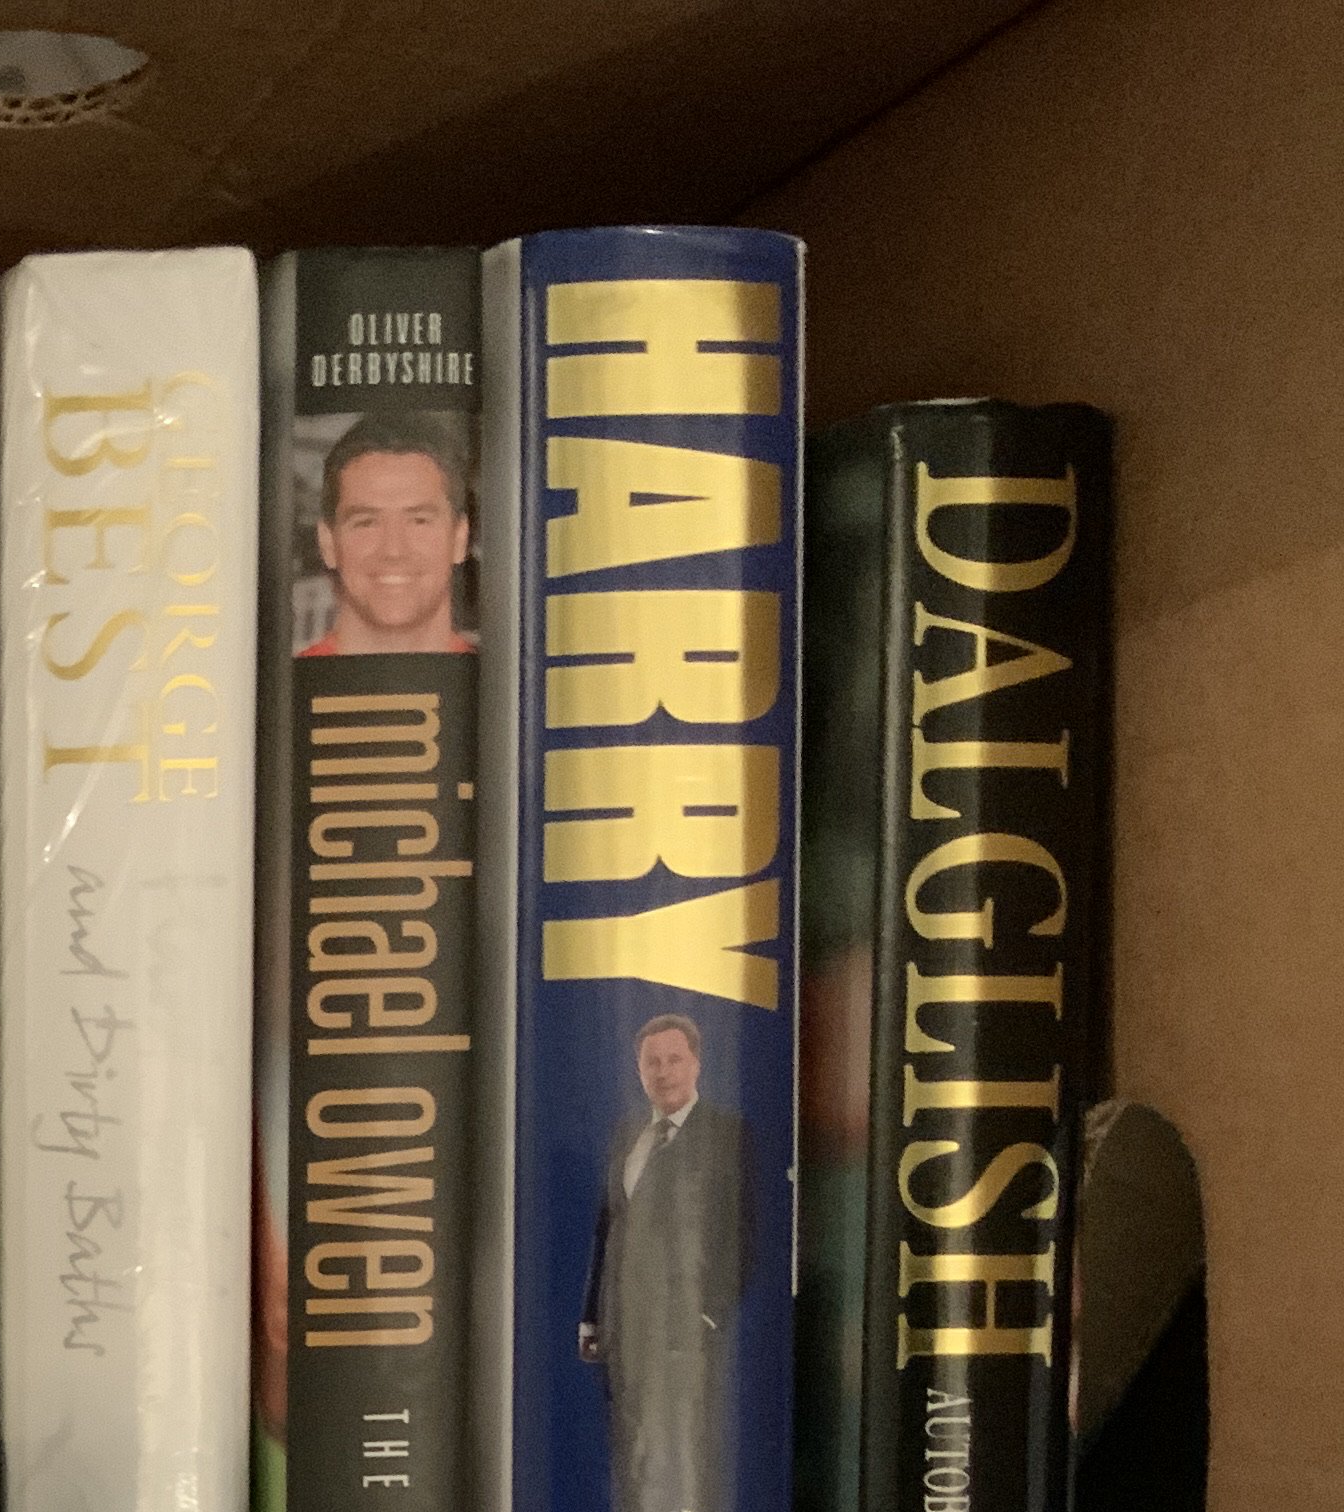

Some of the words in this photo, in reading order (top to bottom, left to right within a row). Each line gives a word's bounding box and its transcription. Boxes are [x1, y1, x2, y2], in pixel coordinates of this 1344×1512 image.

[312, 352, 475, 388] DERBYSHIRE
[349, 313, 443, 346] OLIVER
[43, 375, 153, 805] BEST
[542, 279, 781, 1011] HARRY
[59, 864, 130, 981] and
[305, 691, 475, 1056] michael
[896, 461, 1078, 1371] DALGLISH
[30, 1004, 137, 1161] Dirty
[59, 1179, 137, 1357] Baths
[303, 1086, 438, 1348] owen
[362, 1408, 410, 1489] THE
